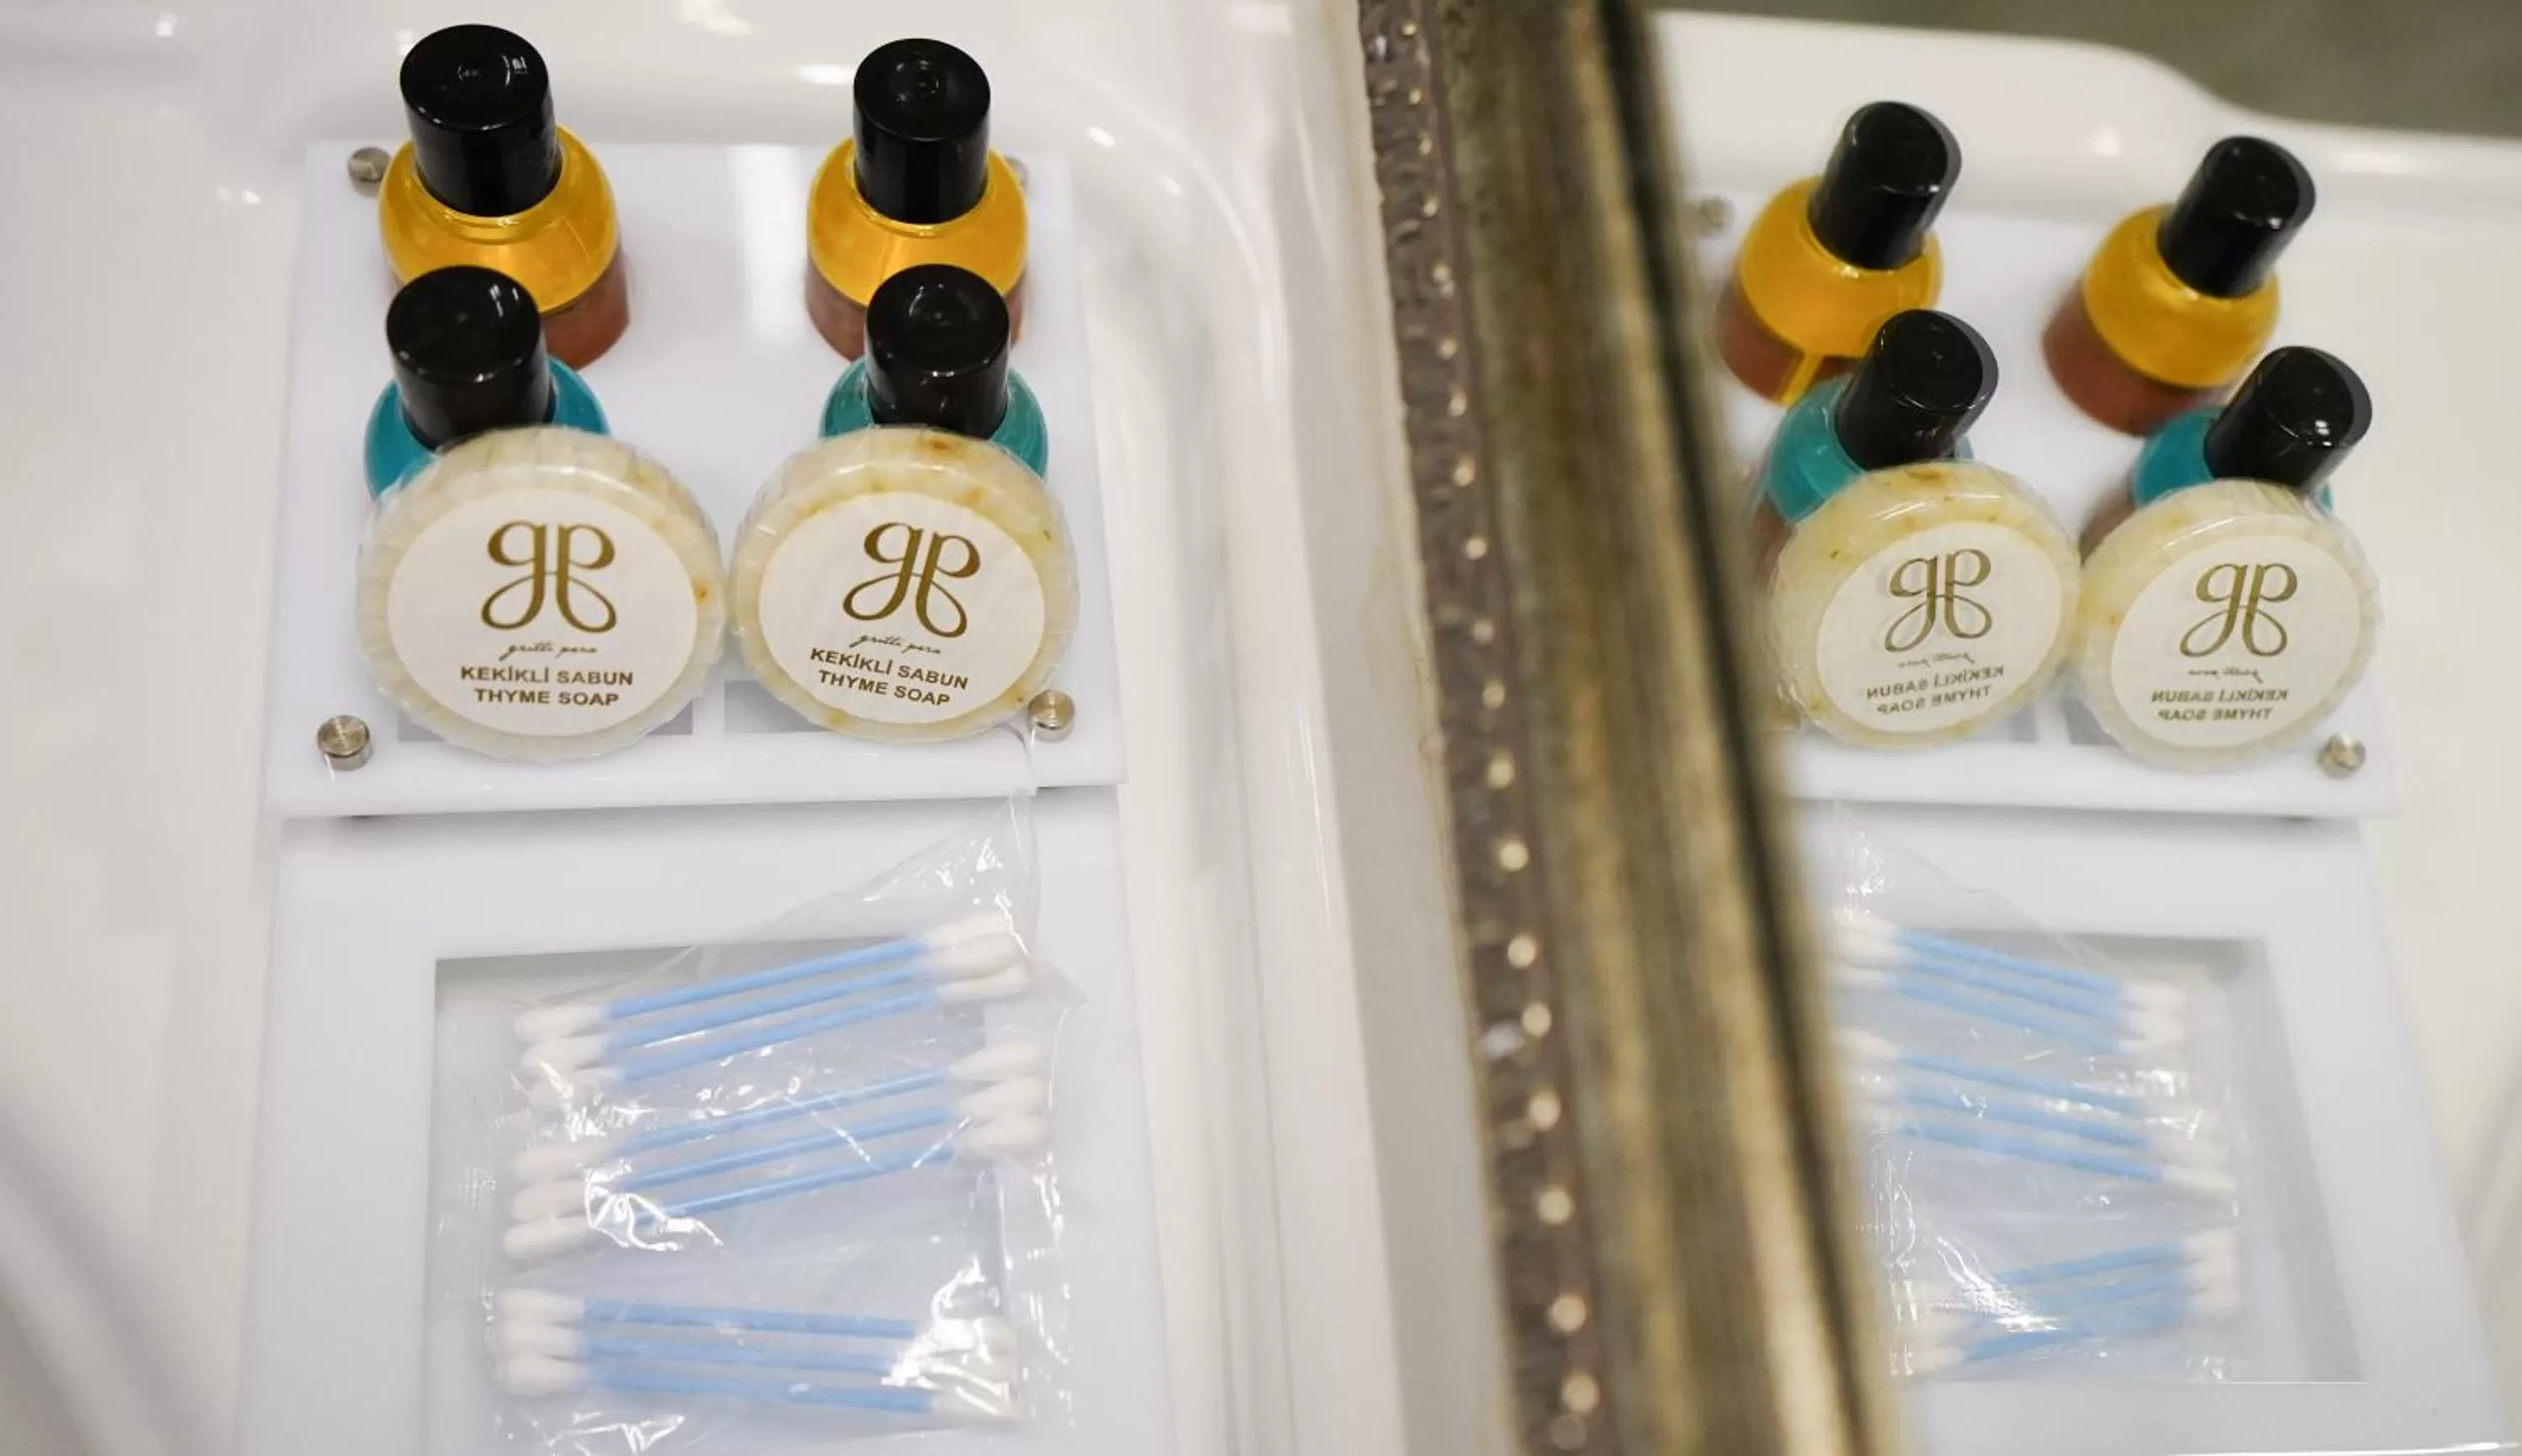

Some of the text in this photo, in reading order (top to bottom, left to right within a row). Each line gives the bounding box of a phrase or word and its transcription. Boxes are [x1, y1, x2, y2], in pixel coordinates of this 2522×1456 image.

[460, 665, 634, 686] KEKİKLİ SABUN
[810, 647, 969, 690] KEKİKLİ SABUN
[474, 687, 620, 707] THYME SOAP
[818, 669, 951, 707] THYME SOAP
